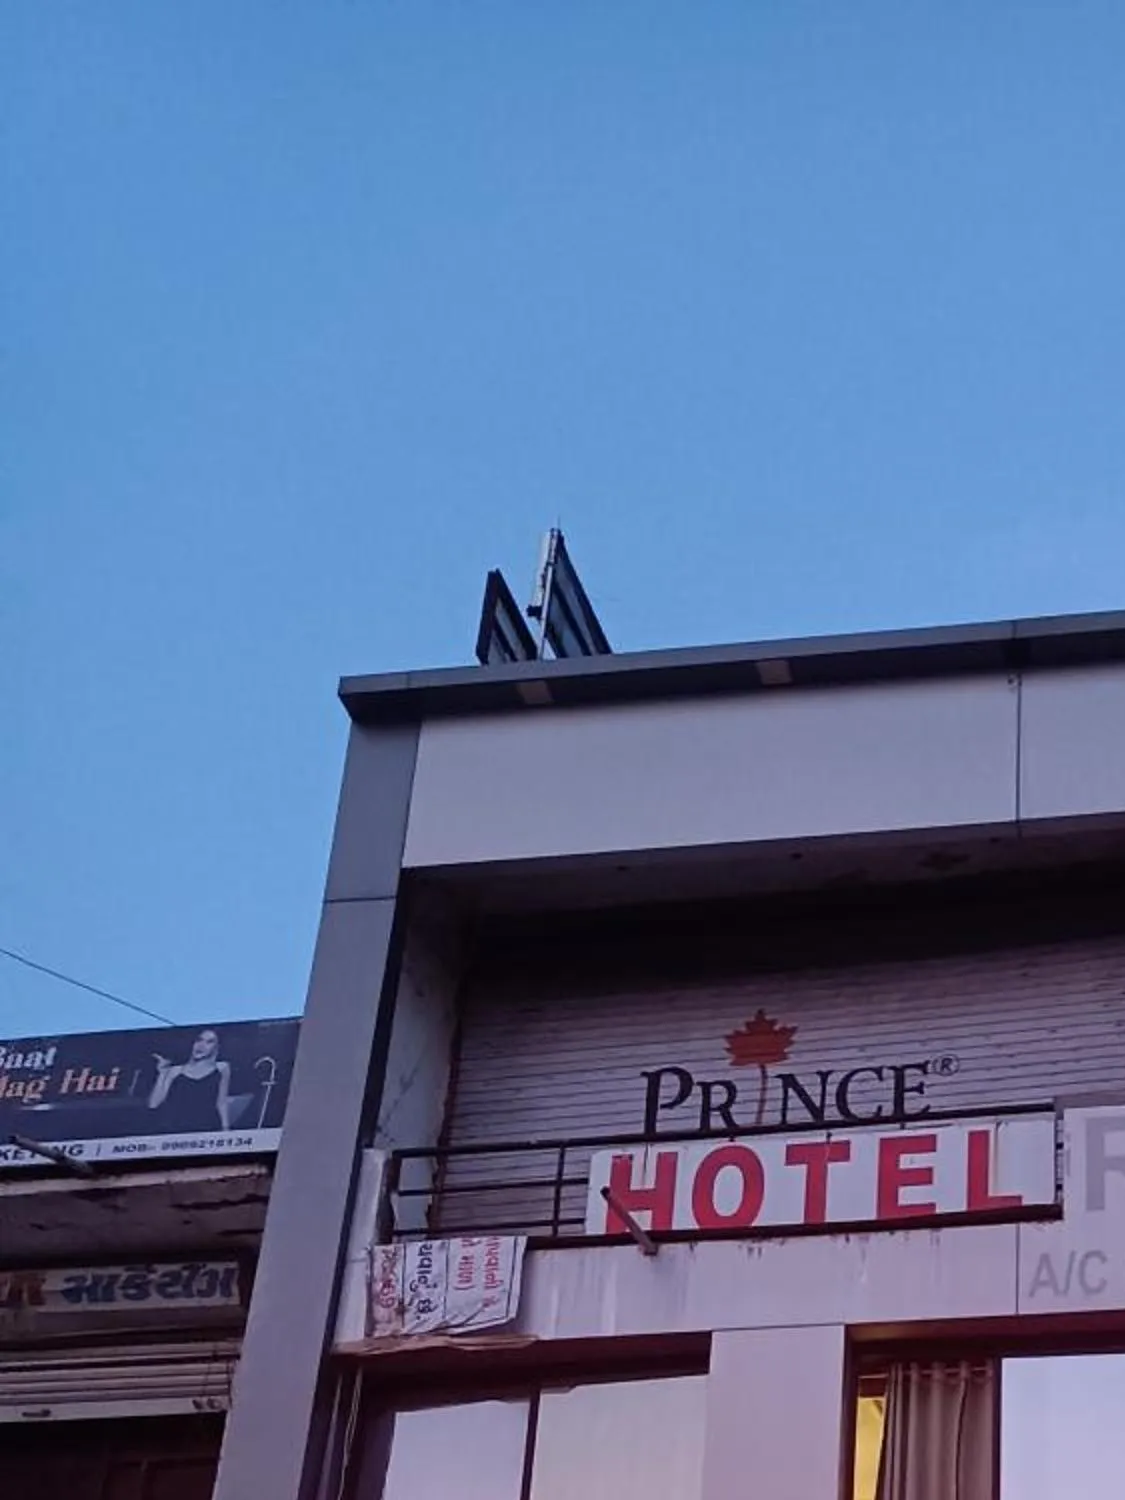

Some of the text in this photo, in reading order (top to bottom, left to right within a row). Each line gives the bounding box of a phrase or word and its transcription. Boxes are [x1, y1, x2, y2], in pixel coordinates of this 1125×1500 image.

[60, 1067, 120, 1095] Hai
[604, 1129, 1024, 1235] HOTEL
[1028, 1250, 1108, 1299] A/C
